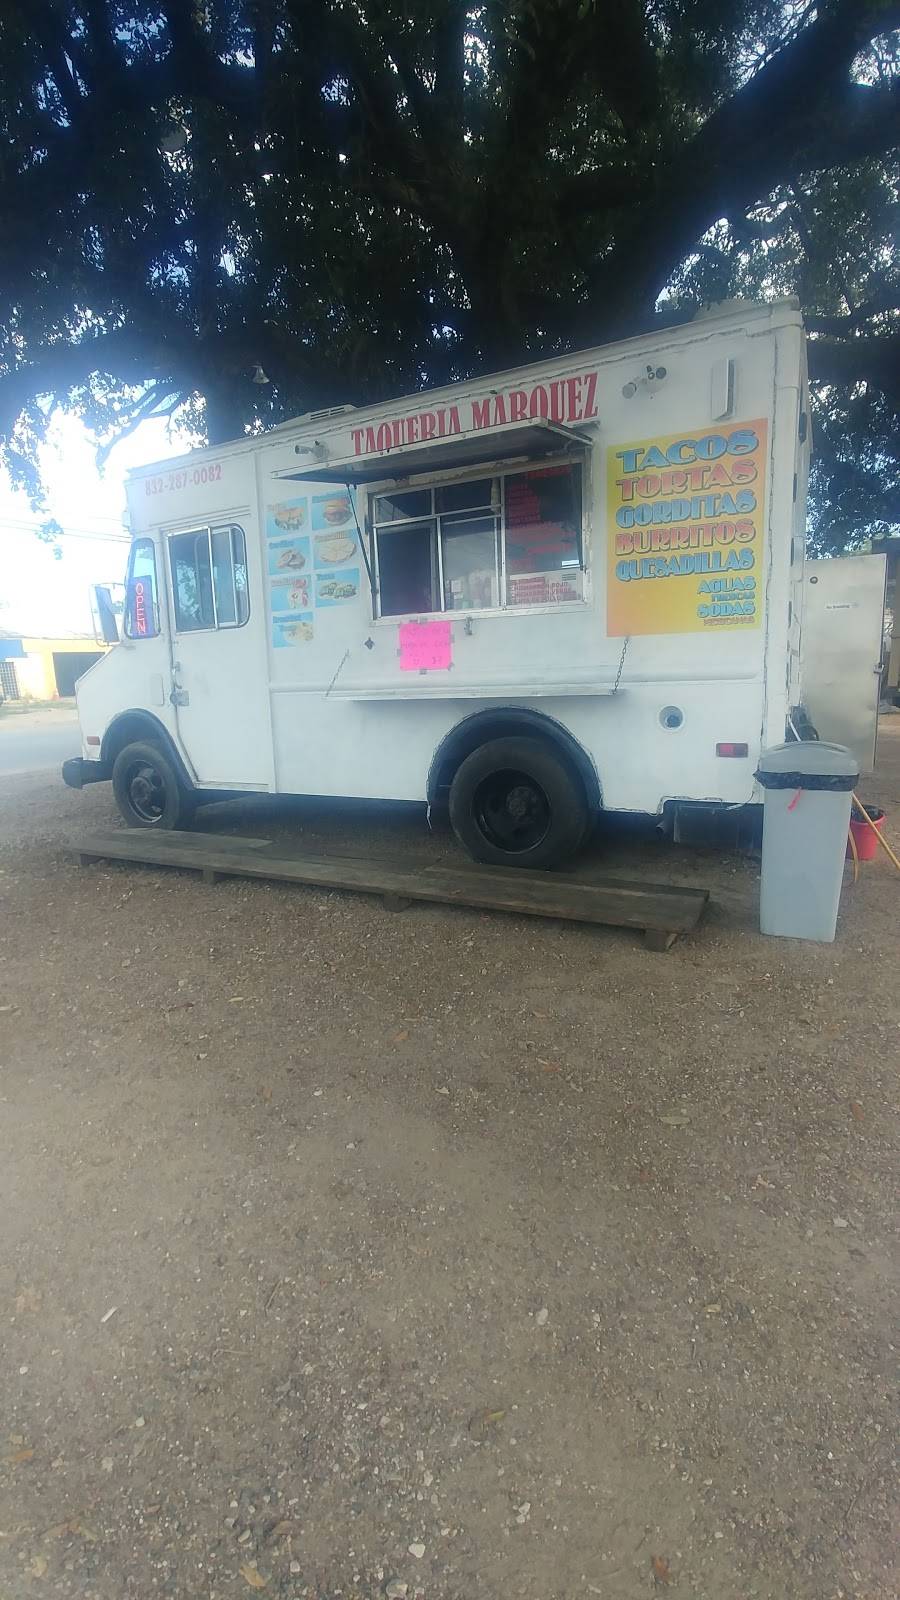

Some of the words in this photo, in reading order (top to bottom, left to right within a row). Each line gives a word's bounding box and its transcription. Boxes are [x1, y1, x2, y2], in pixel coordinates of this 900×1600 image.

[351, 406, 461, 456] TAQUERIA
[471, 372, 599, 430] MARQUEZ
[616, 429, 759, 473] TACOS
[144, 464, 222, 496] 832-287-0082
[616, 460, 758, 501] TORTAS
[615, 488, 757, 529] GORDITAS
[615, 518, 756, 555] BURRITOS
[615, 548, 755, 582] QUESADILLAS
[698, 576, 756, 594] AGUAS
[135, 582, 146, 635] OPEN
[698, 601, 756, 618] SODAS
